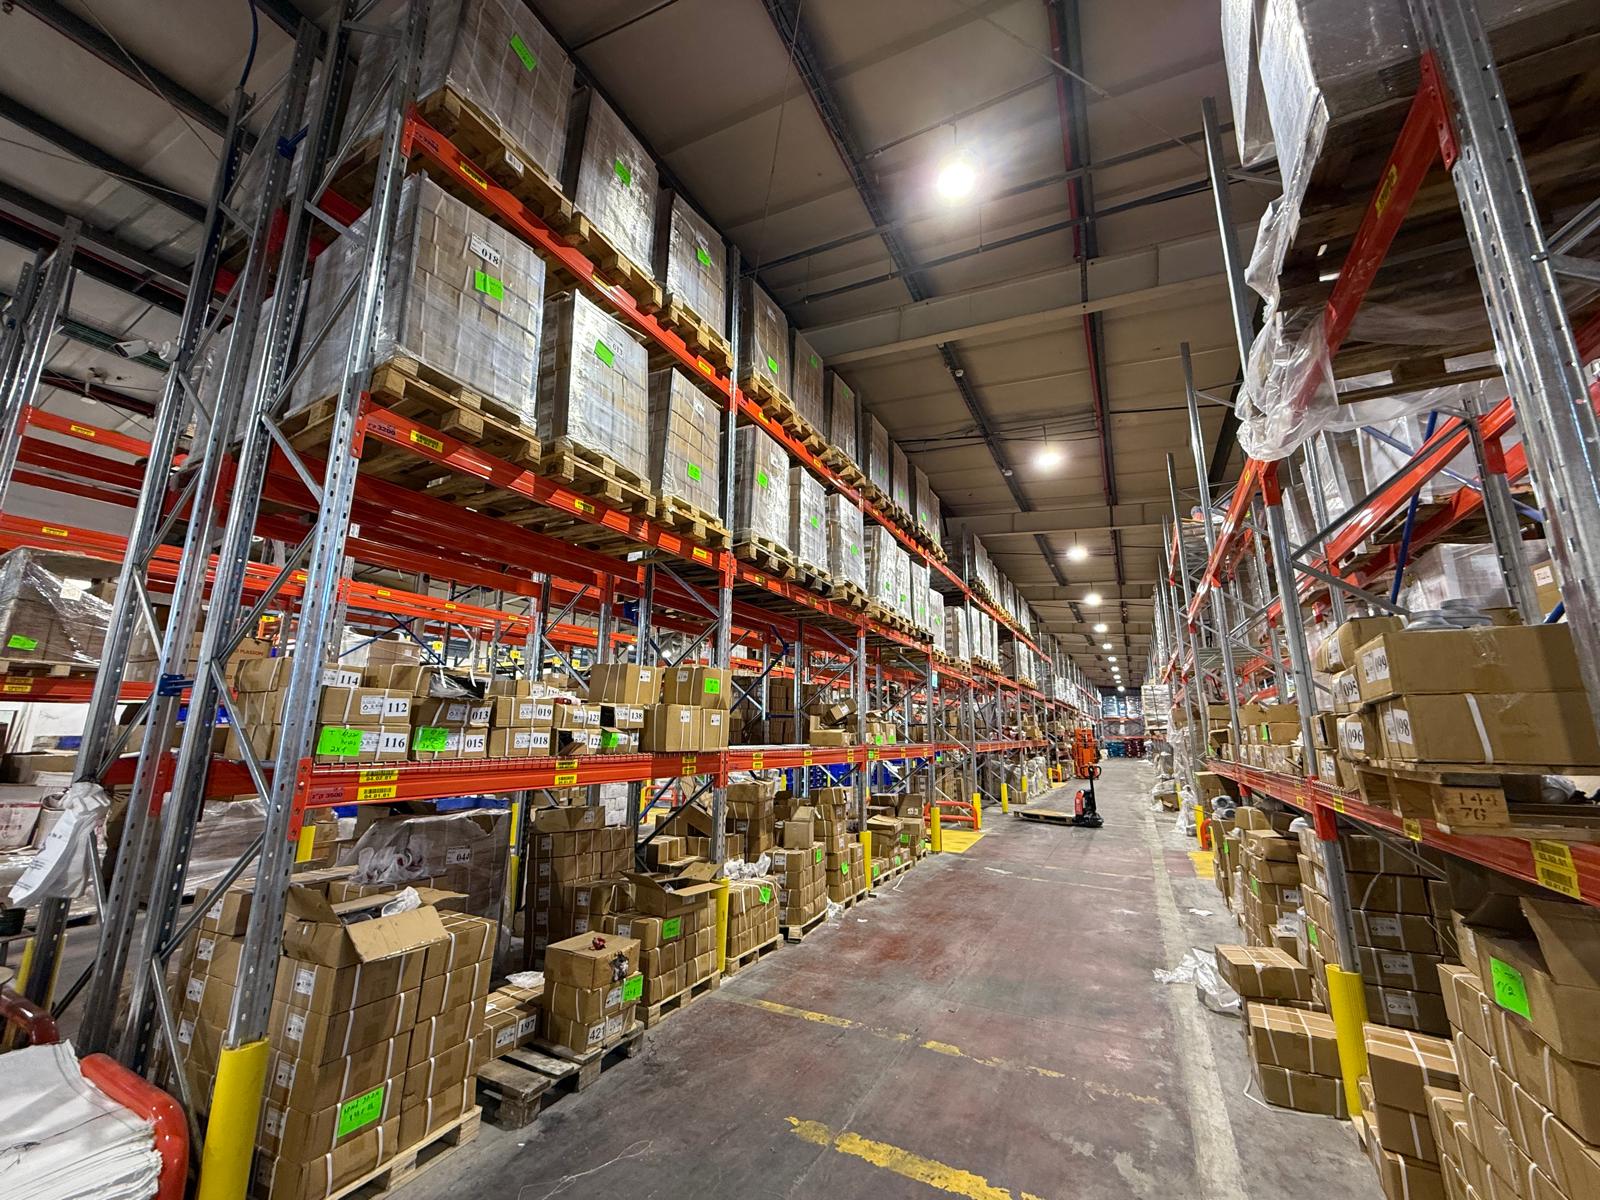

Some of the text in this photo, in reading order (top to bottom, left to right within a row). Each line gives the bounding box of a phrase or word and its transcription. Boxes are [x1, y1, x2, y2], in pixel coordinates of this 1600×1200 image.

[481, 248, 499, 265] 018
[340, 674, 359, 686] 114
[388, 702, 407, 713] 112
[537, 708, 552, 717] 019
[472, 711, 489, 721] 013
[631, 712, 643, 720] 138
[533, 736, 548, 745] 018
[1347, 729, 1363, 744] 096
[384, 737, 405, 748] 116
[466, 738, 484, 748] 015
[520, 1019, 535, 1033] 197
[588, 1025, 605, 1041] 421
